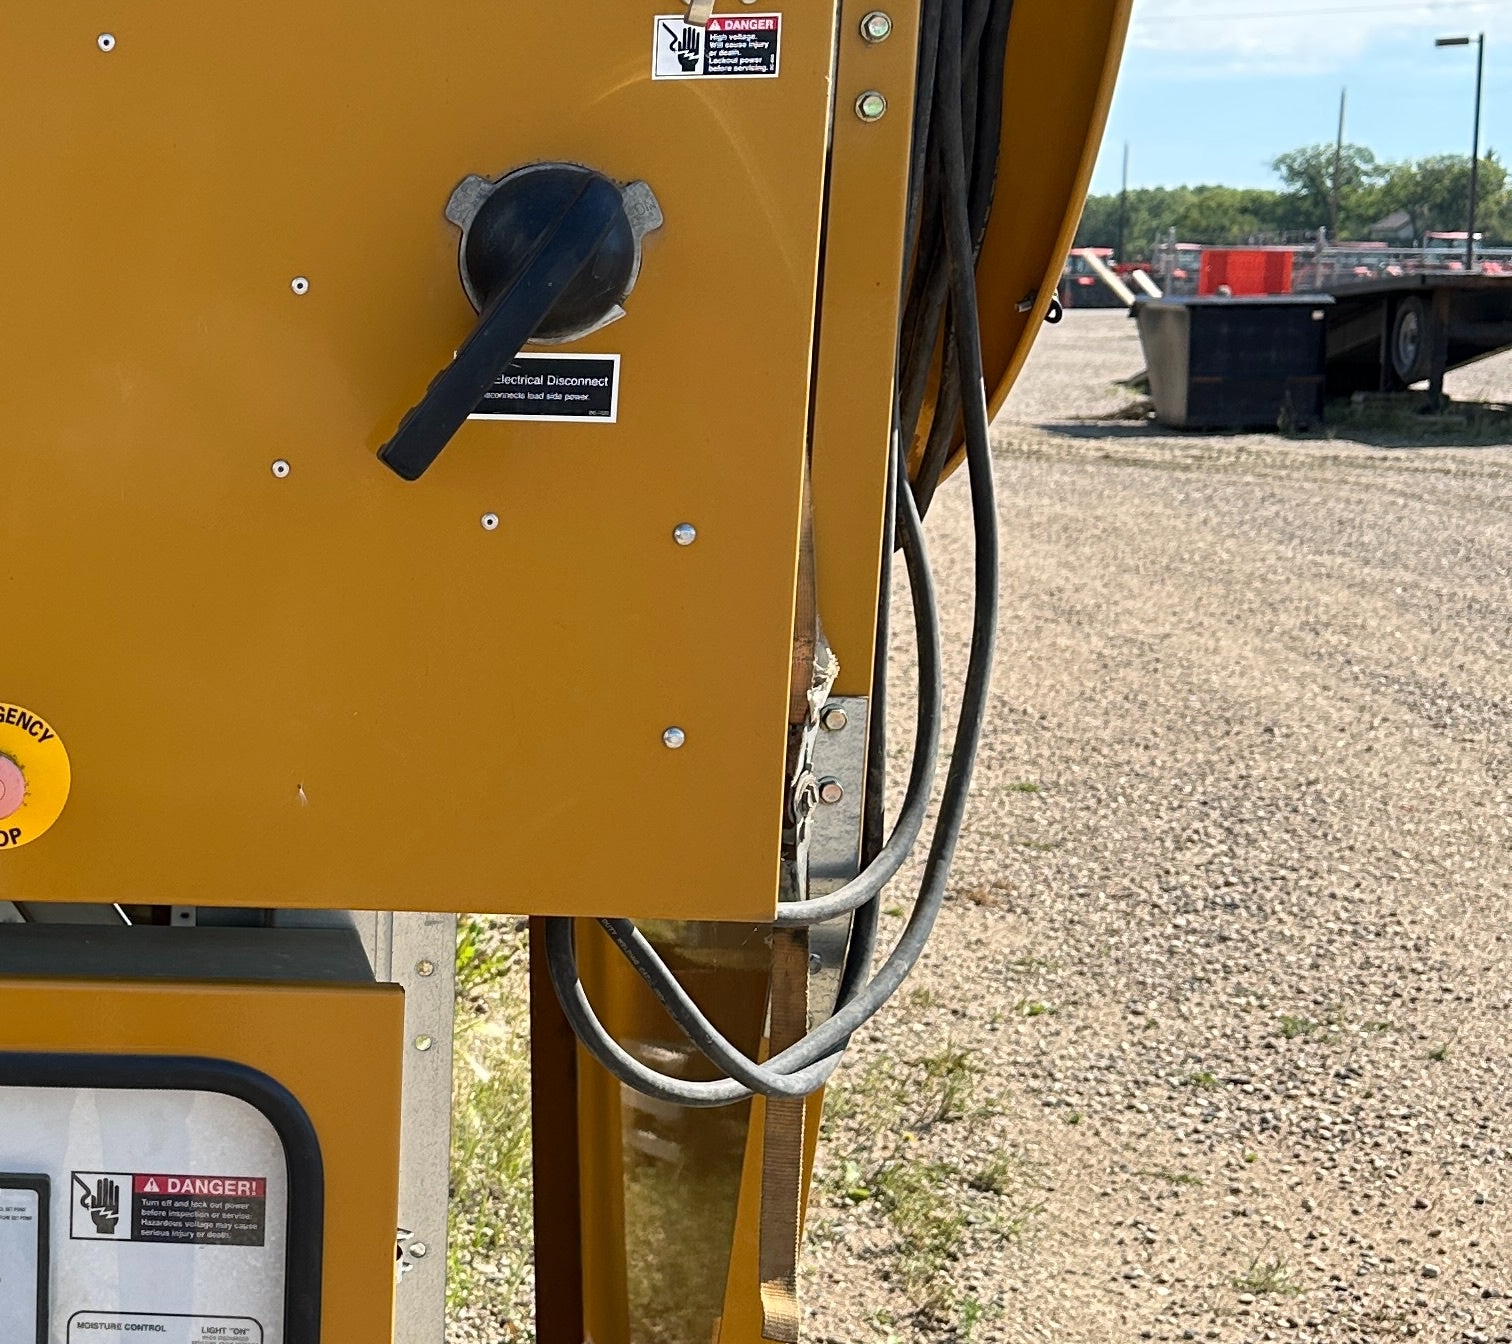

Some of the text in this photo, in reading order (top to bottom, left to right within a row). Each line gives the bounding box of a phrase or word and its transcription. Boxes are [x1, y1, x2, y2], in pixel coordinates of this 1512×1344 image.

[724, 19, 774, 30] DANGER
[547, 375, 608, 386] Disconnect
[167, 1179, 257, 1196] DANGER!
[76, 1321, 166, 1332] MOISTURE CONTROL
[201, 1327, 226, 1335] LIGHT
